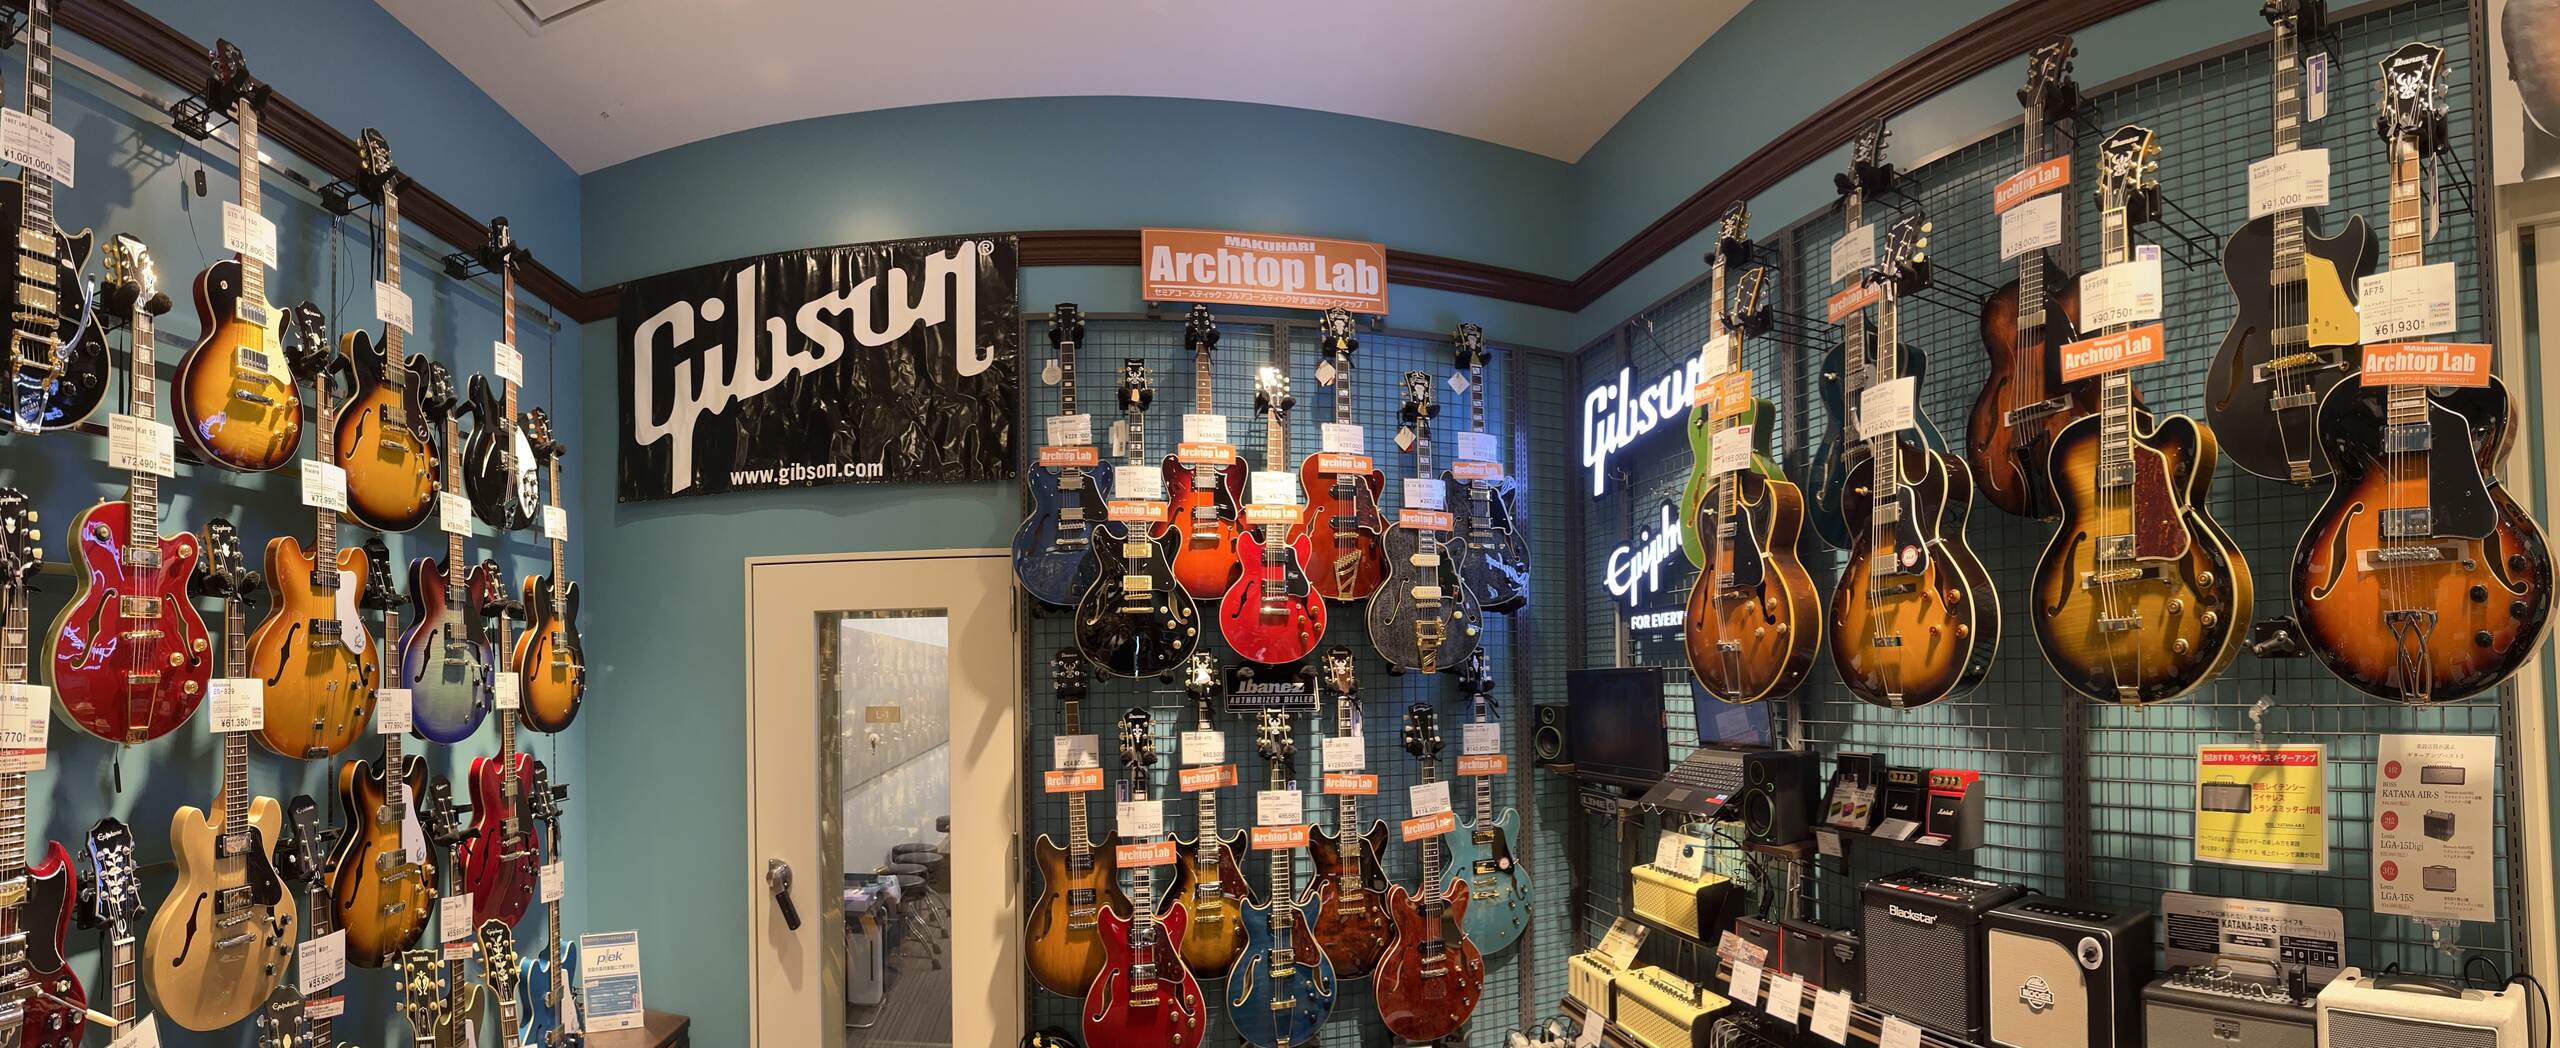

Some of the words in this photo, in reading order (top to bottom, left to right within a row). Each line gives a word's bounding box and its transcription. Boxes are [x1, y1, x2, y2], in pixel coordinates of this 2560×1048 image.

[2393, 55, 2428, 67] Ibanez
[1225, 235, 1316, 253] MAKUHARI
[1149, 245, 1306, 293] Archtop
[1314, 254, 1379, 296] Lab
[2363, 286, 2385, 297] AF75
[2375, 318, 2421, 337] ¥61,930
[2065, 341, 2123, 370] Archtop
[2125, 335, 2152, 357] Lab
[2365, 352, 2437, 374] Archtop
[2442, 352, 2476, 374] Lab
[1041, 451, 1076, 462] Archtop
[1076, 450, 1092, 461] Lab
[1181, 447, 1214, 459] Archtop
[1214, 447, 1230, 458] Lab
[1320, 458, 1354, 470] Archtop
[1354, 459, 1368, 469] Lab
[730, 461, 884, 487] www.gibson.com
[1109, 504, 1145, 518] Archtop
[1146, 507, 1162, 517] Lab
[1401, 514, 1434, 526] Archtop
[1434, 516, 1448, 526] Lab
[1631, 613, 1651, 630] FOR
[1235, 680, 1305, 695] Ibanez
[1229, 695, 1281, 705] AUTHORIZED
[1283, 695, 1314, 704] DEALER
[1459, 760, 1488, 771] Archtop
[1489, 759, 1503, 769] Lab
[1047, 776, 1081, 788] Archtop
[1081, 774, 1097, 785] Lab
[1183, 773, 1216, 786] Archtop
[1217, 771, 1232, 782] Lab
[1326, 777, 1358, 789] Archtop
[1359, 778, 1373, 788] Lab
[2382, 789, 2416, 799] KATANA
[2417, 790, 2440, 800] AIR-S
[1404, 821, 1437, 836] Archtop
[1254, 832, 1288, 844] Archtop
[1288, 830, 1304, 842] Lab
[2380, 840, 2425, 852] LGA-15Digi
[1118, 849, 1153, 862] Archtop
[1154, 847, 1170, 859] Lab
[2382, 867, 2396, 877] 3位
[2380, 891, 2415, 903] LGA-15S
[1889, 904, 1938, 925] Blackstar
[2221, 917, 2277, 935] KATANA-AIR-S
[2022, 987, 2053, 1003] MOOER
